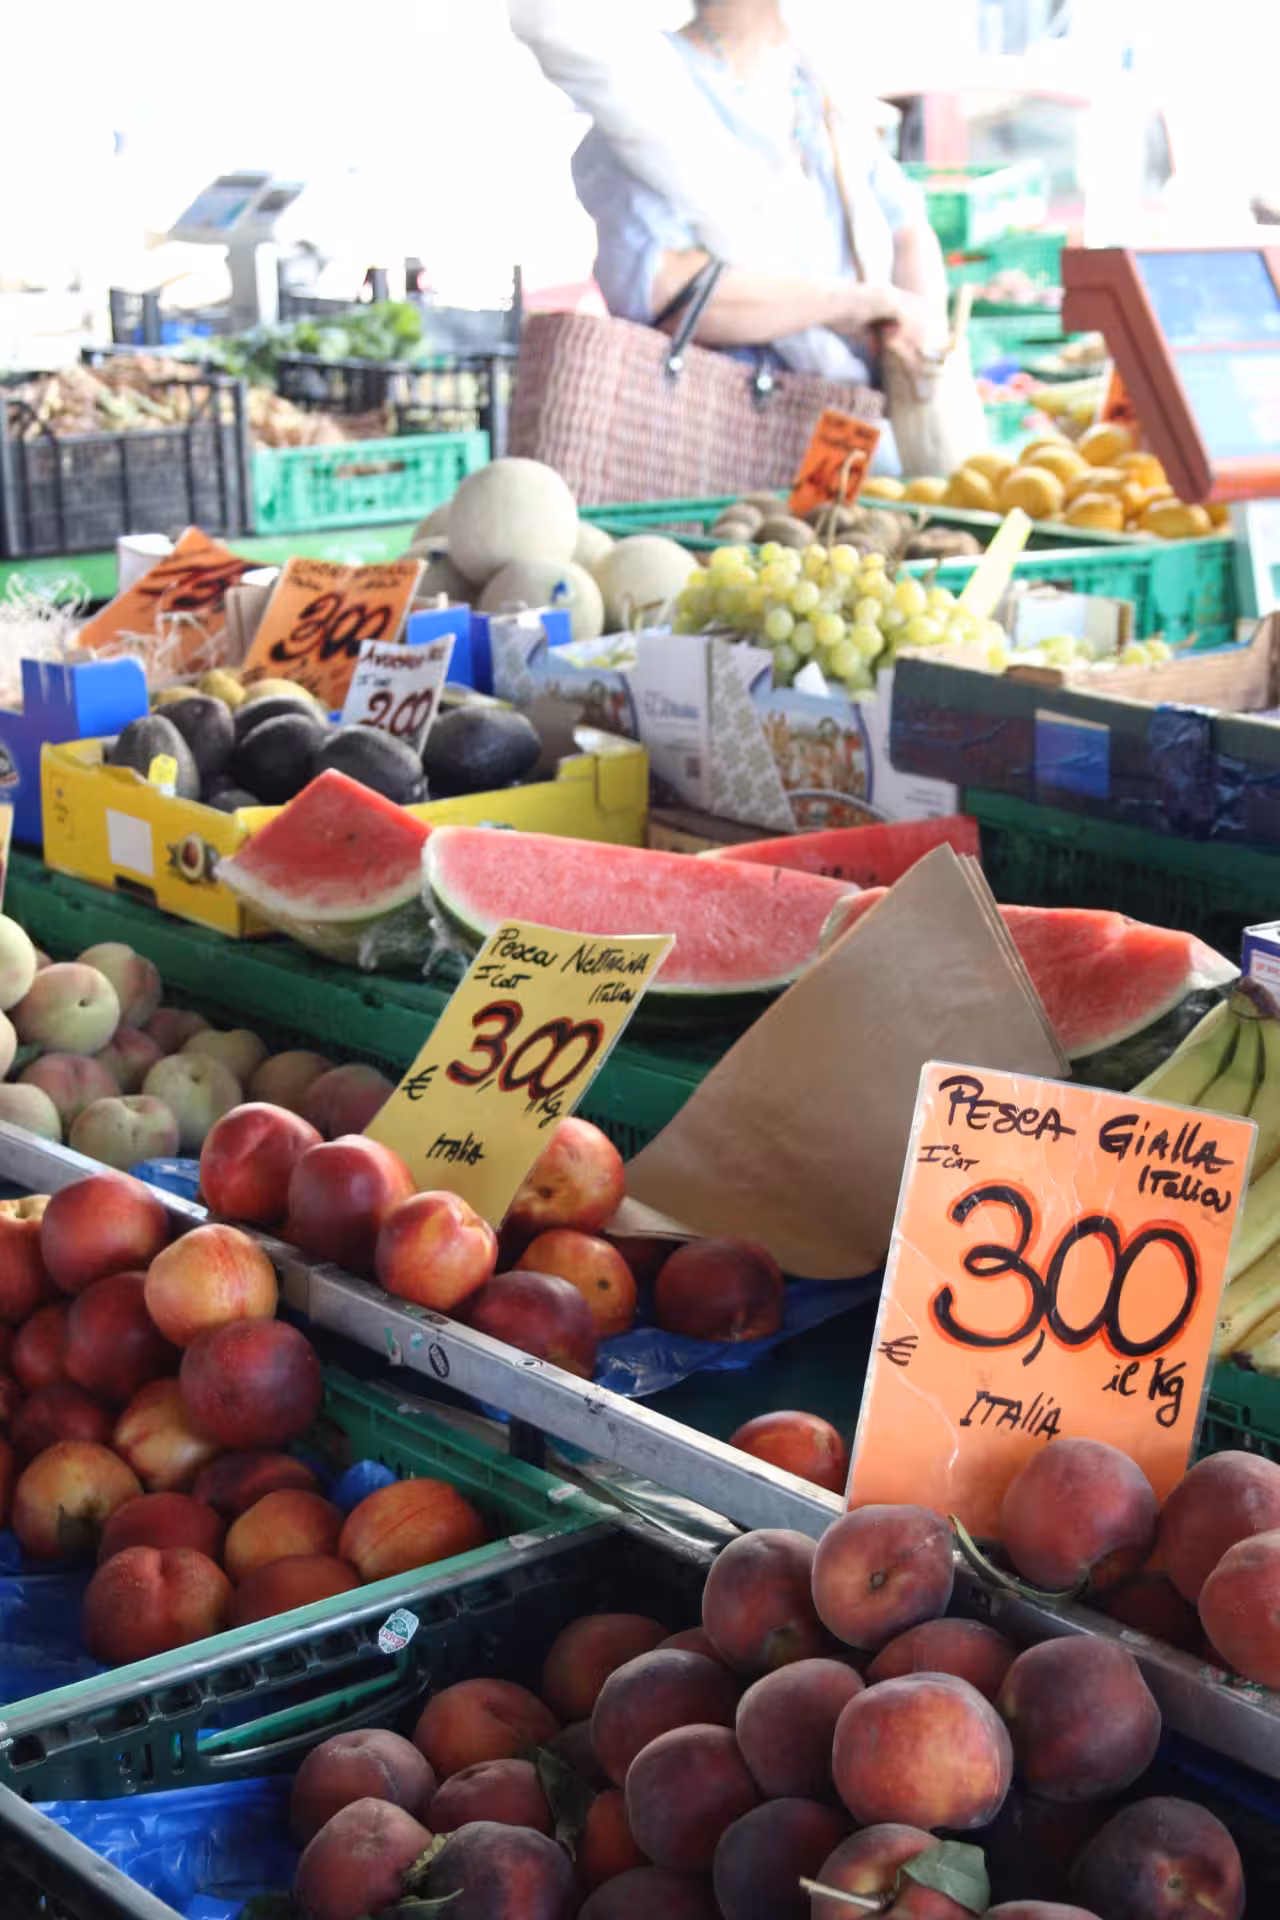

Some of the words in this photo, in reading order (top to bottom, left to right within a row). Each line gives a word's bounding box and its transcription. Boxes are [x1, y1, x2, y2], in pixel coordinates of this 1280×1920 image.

[401, 1065, 439, 1100] €
[445, 999, 604, 1100] 3,00
[939, 1075, 1076, 1142] PESCA
[929, 1179, 1202, 1367] 3,00
[877, 1335, 919, 1366] €
[1149, 1357, 1186, 1428] Kg
